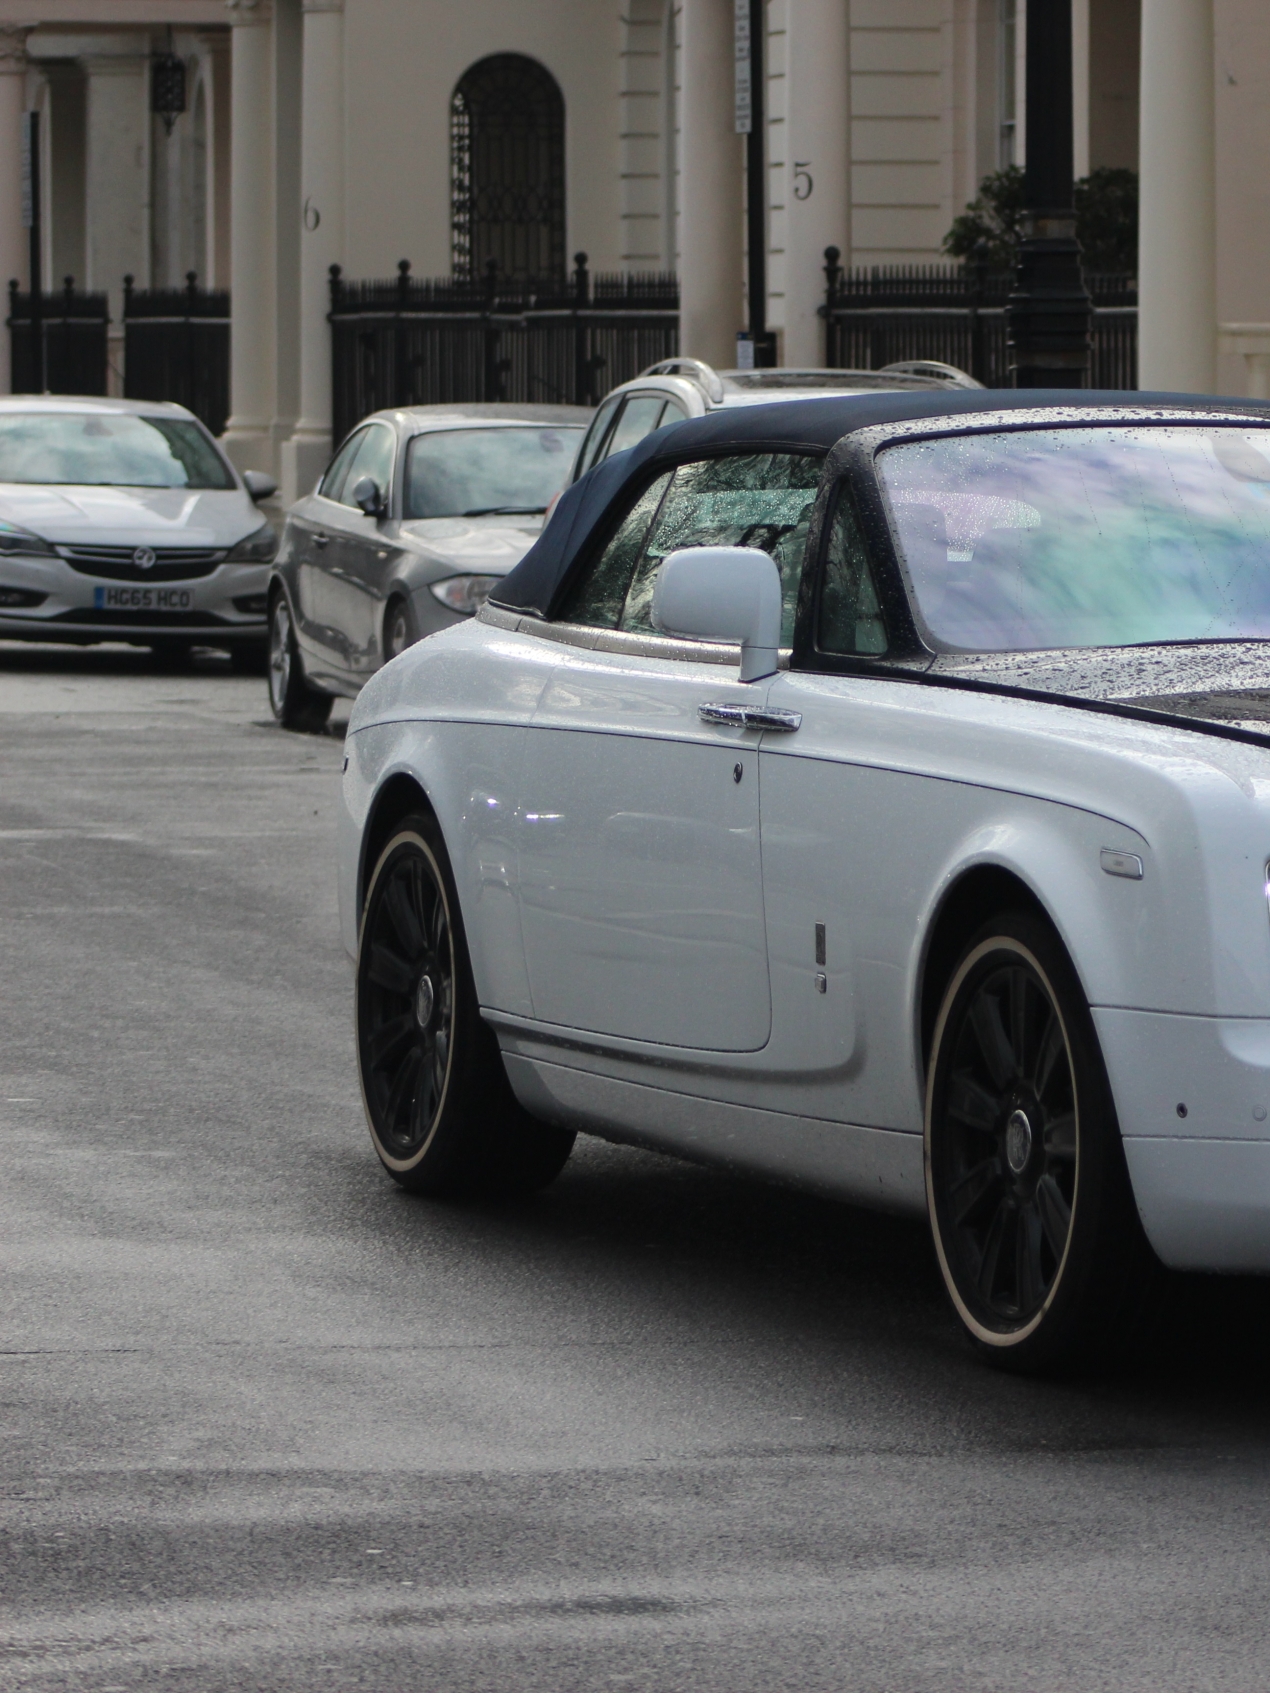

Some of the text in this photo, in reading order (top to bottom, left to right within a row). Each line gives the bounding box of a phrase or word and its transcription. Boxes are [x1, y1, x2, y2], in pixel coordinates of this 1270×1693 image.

[794, 161, 813, 201] 5
[303, 196, 321, 232] 6
[107, 588, 152, 606] HG65
